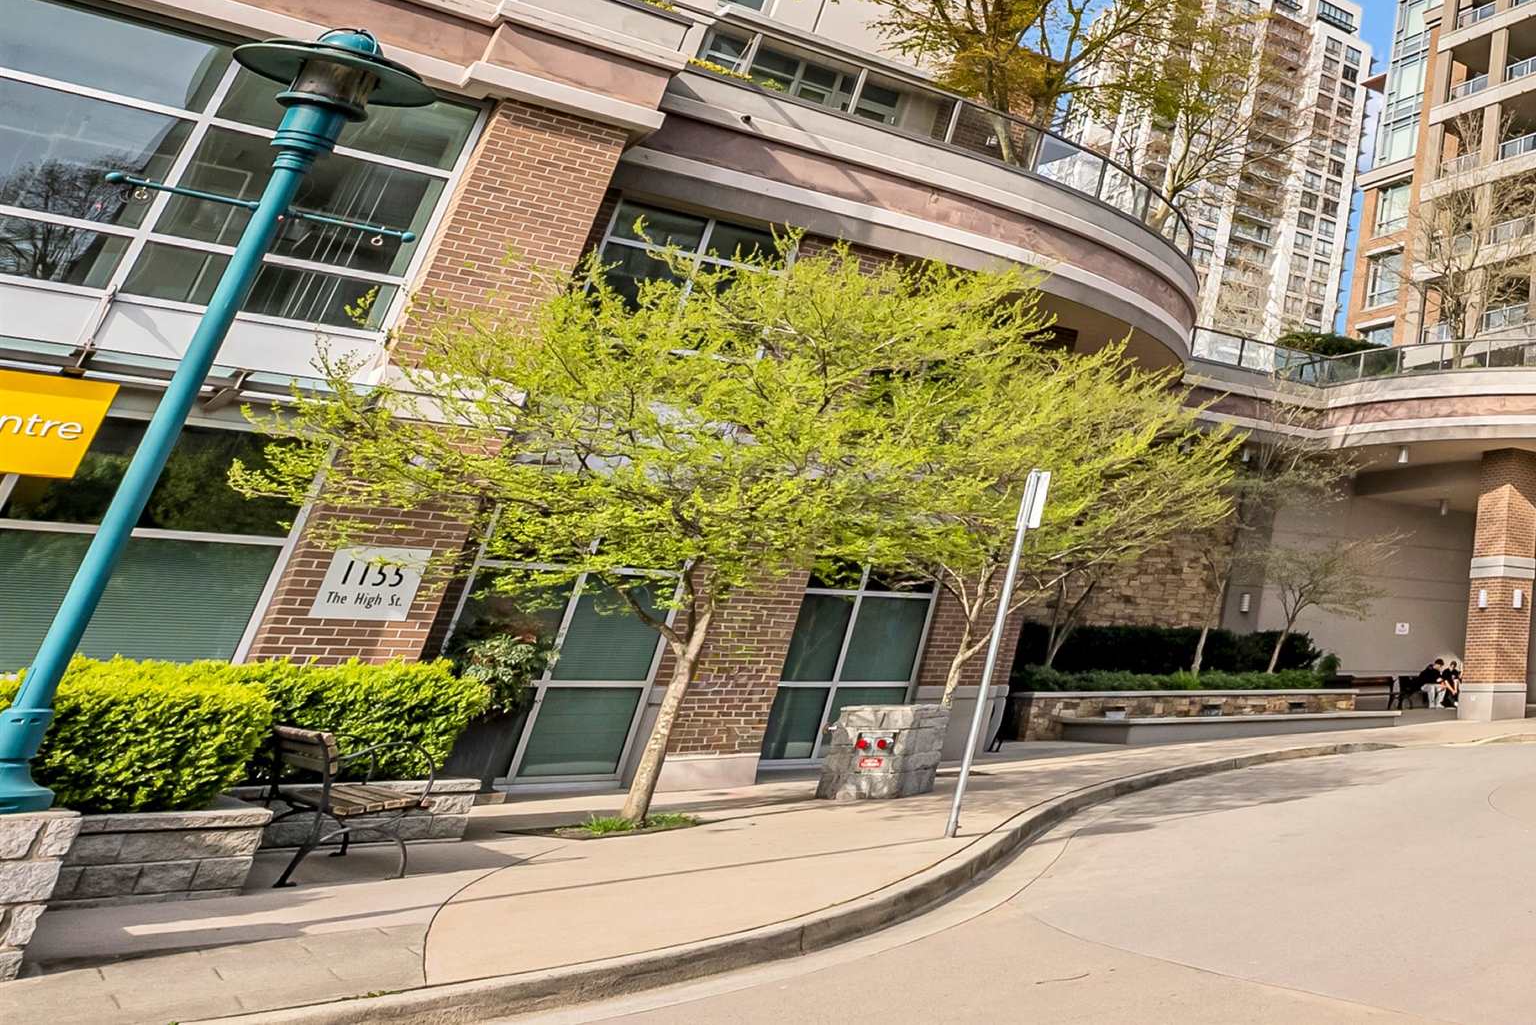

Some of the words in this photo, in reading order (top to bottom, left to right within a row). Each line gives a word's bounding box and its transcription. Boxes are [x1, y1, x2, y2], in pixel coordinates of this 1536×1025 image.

[341, 559, 404, 587] 1155
[326, 591, 348, 605] The
[354, 592, 382, 609] High
[388, 594, 403, 607] St.
